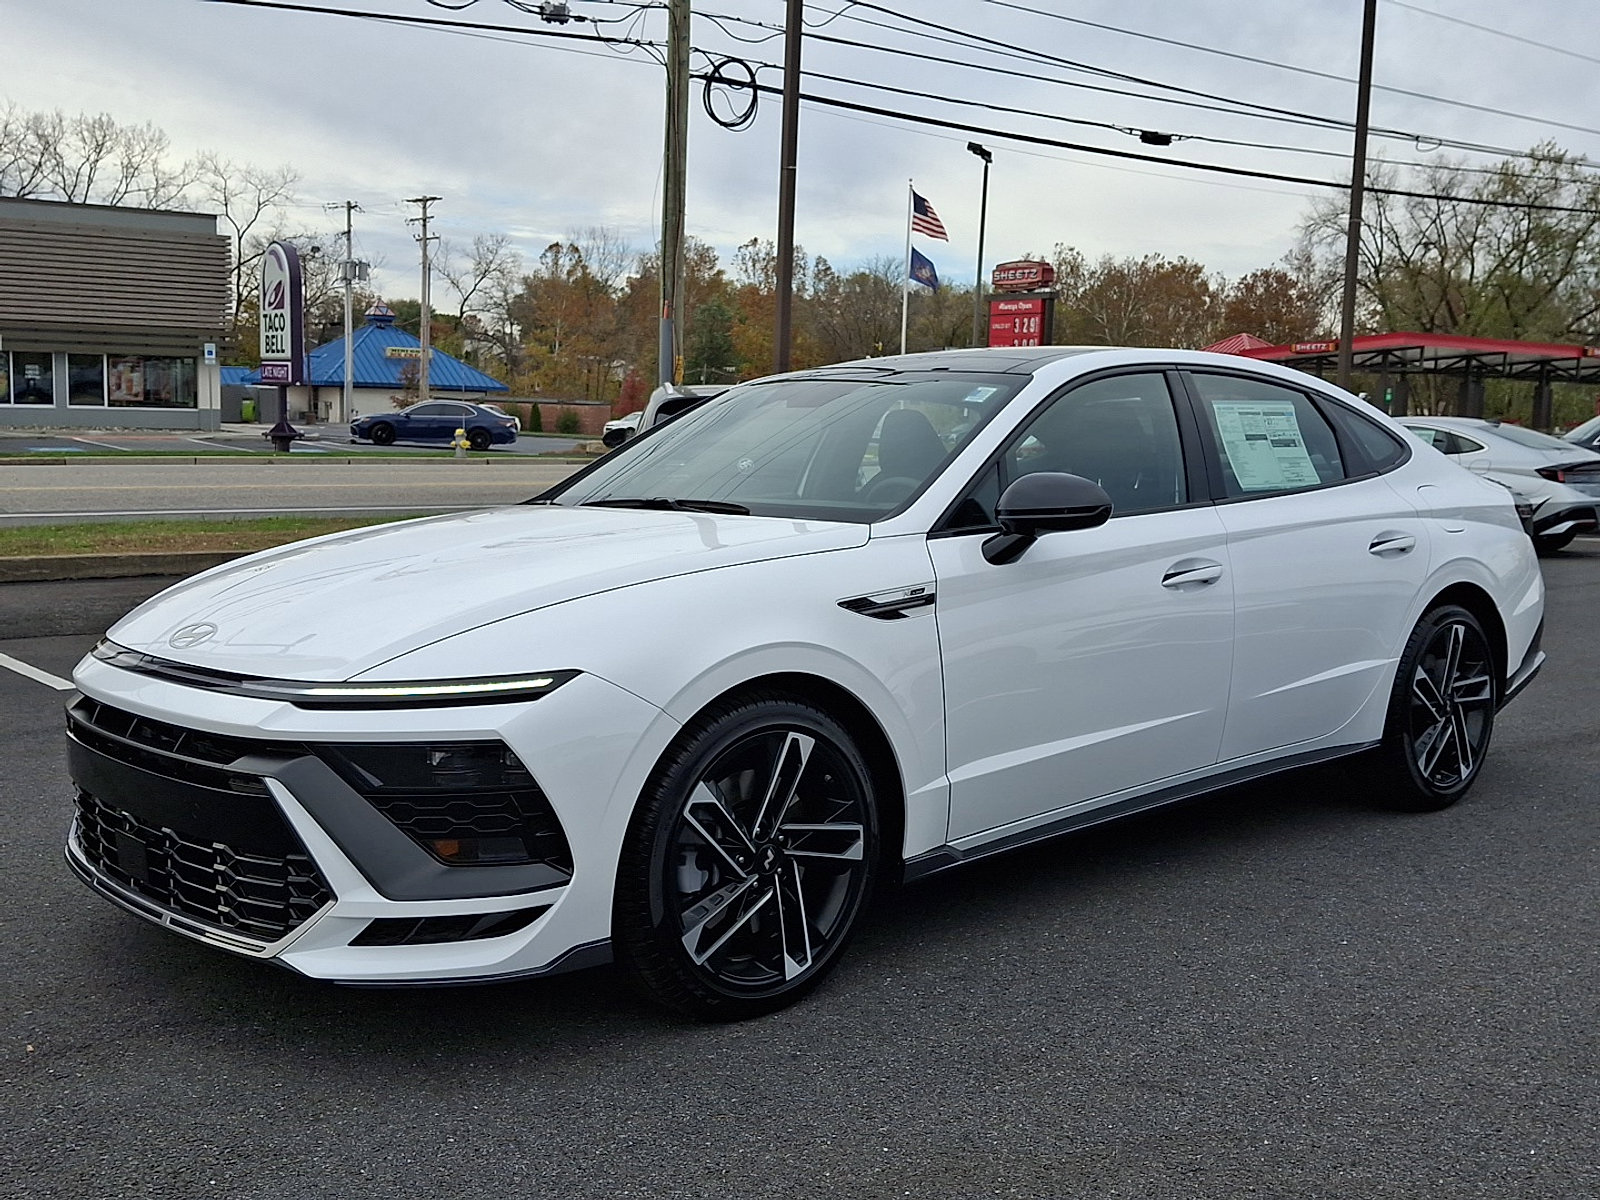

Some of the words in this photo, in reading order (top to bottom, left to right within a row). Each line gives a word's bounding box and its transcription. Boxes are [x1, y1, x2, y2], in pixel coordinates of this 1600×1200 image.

[994, 269, 1037, 280] SHEETZ
[1018, 302, 1032, 310] Open
[263, 313, 285, 332] TACO
[265, 335, 285, 353] BELL
[1296, 343, 1327, 351] SHEETZ
